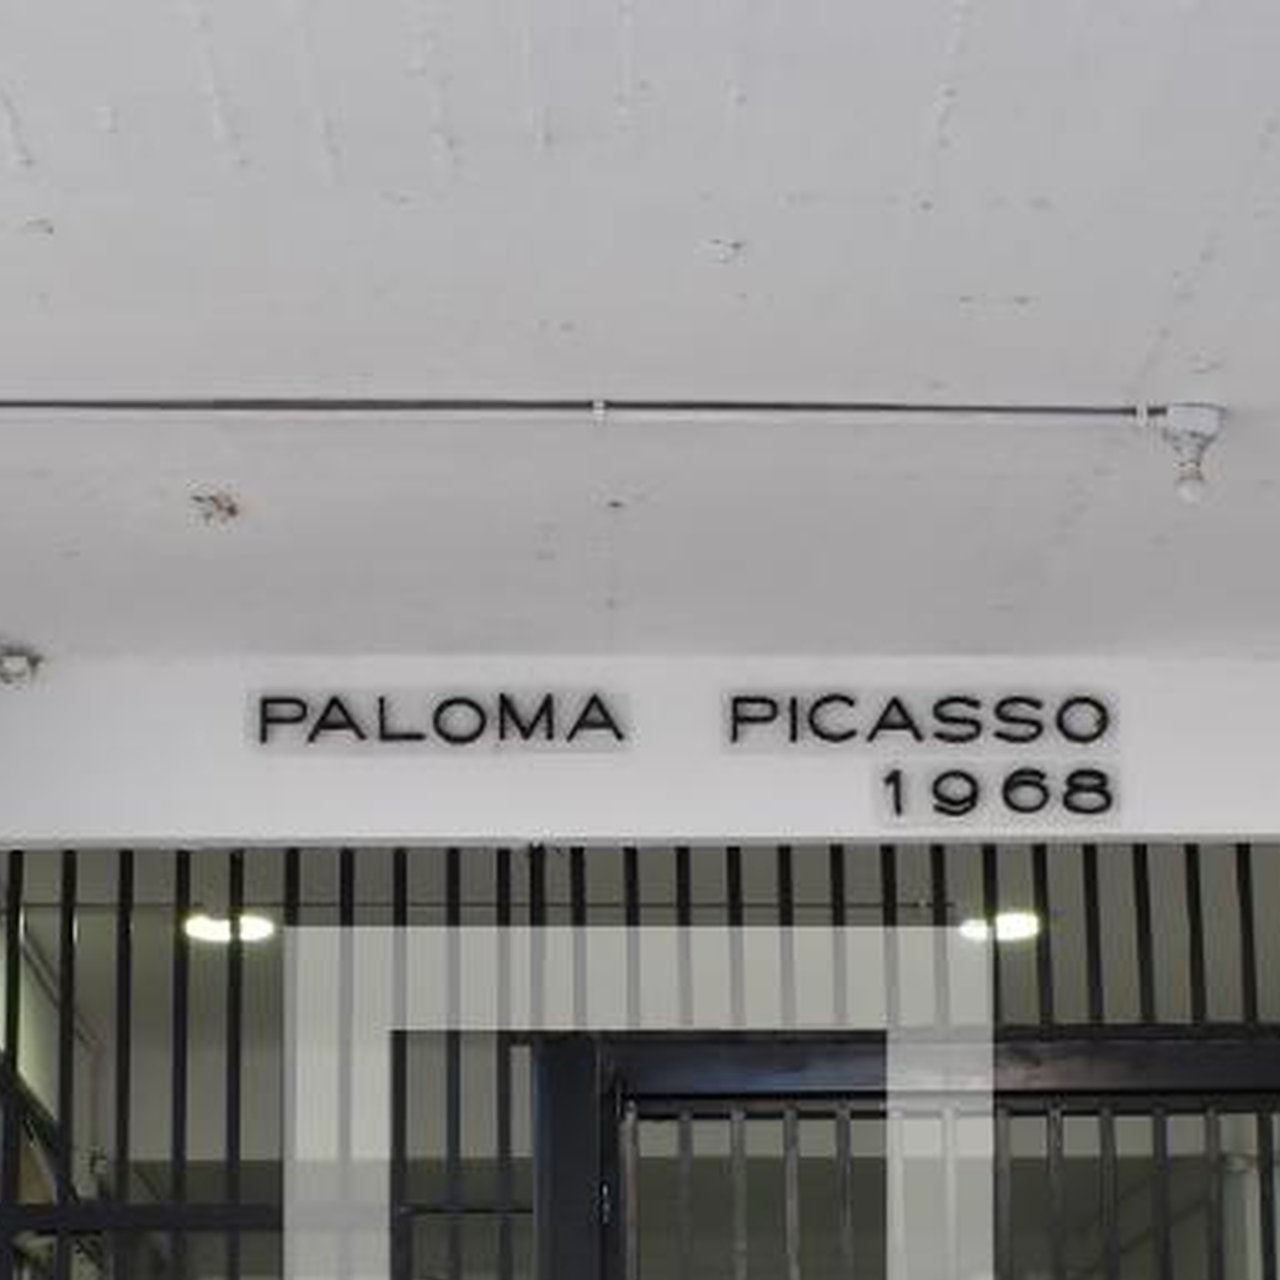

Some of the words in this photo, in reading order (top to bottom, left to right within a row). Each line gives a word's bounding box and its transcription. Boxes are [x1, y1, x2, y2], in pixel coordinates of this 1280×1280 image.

[258, 692, 625, 746] PALOMA
[729, 692, 1111, 746] PICASSO
[882, 767, 1114, 818] 1968
